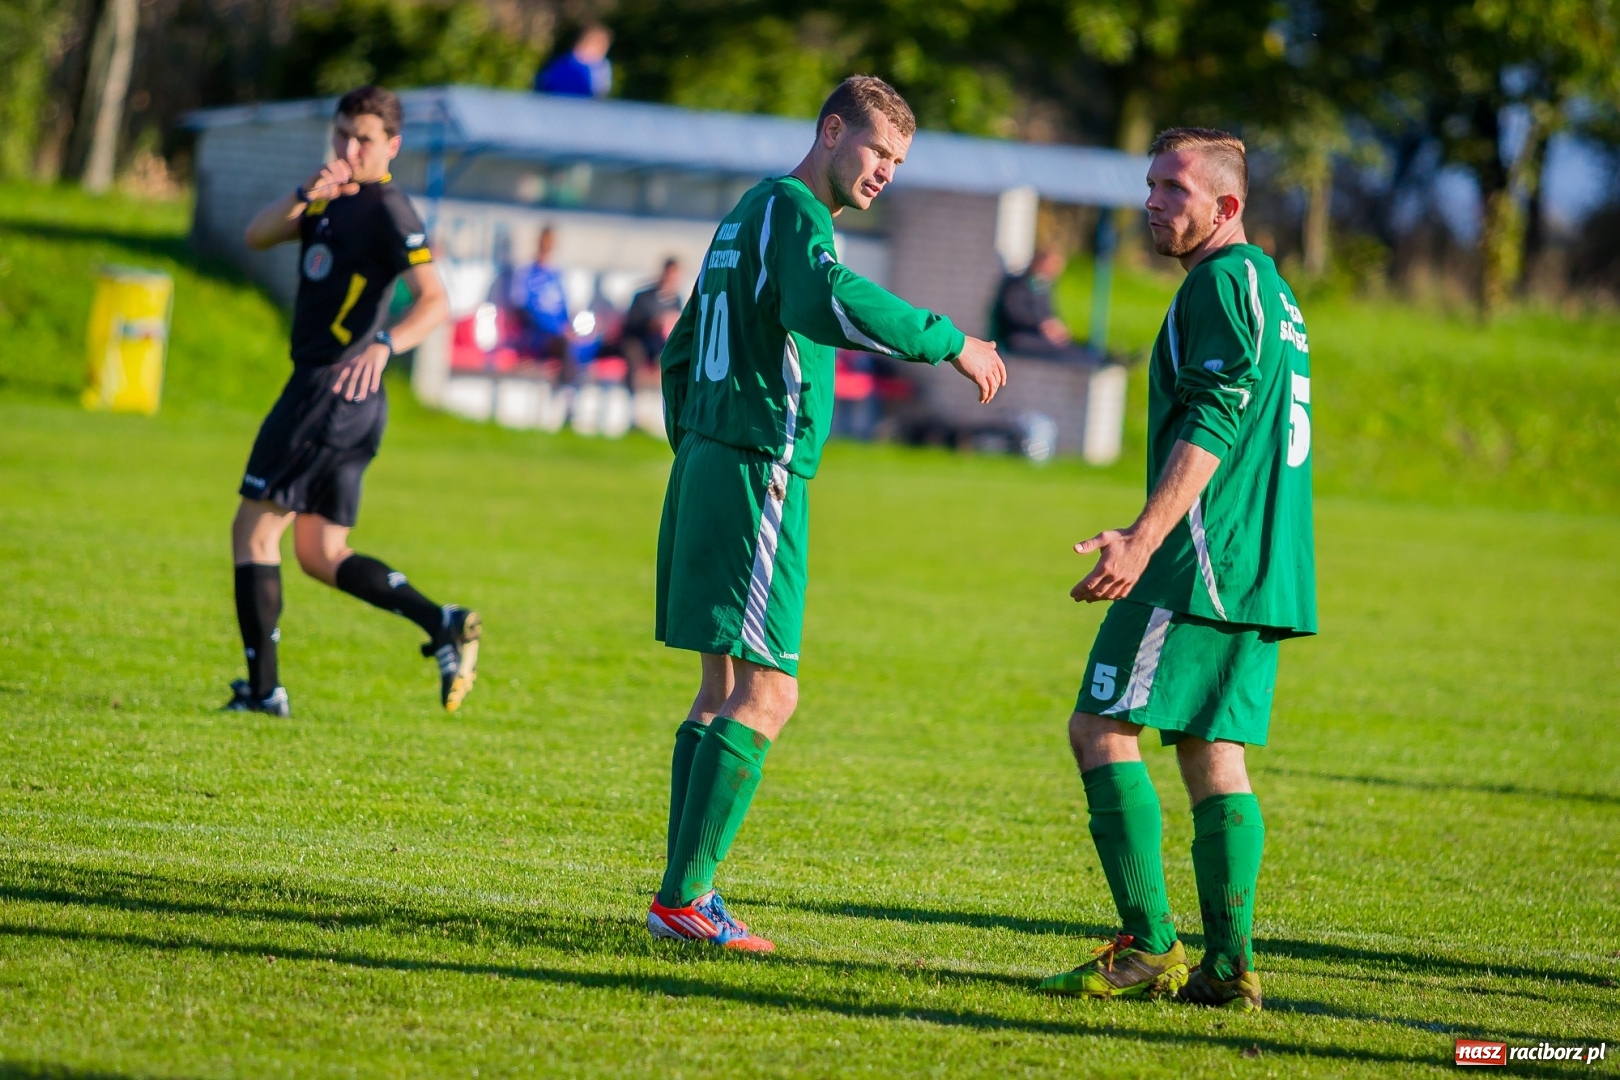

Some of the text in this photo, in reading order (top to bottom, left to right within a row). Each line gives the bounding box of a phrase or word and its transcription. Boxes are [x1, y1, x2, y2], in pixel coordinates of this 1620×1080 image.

[696, 291, 730, 382] 10
[1286, 370, 1311, 468] 5
[1091, 662, 1117, 701] 5
